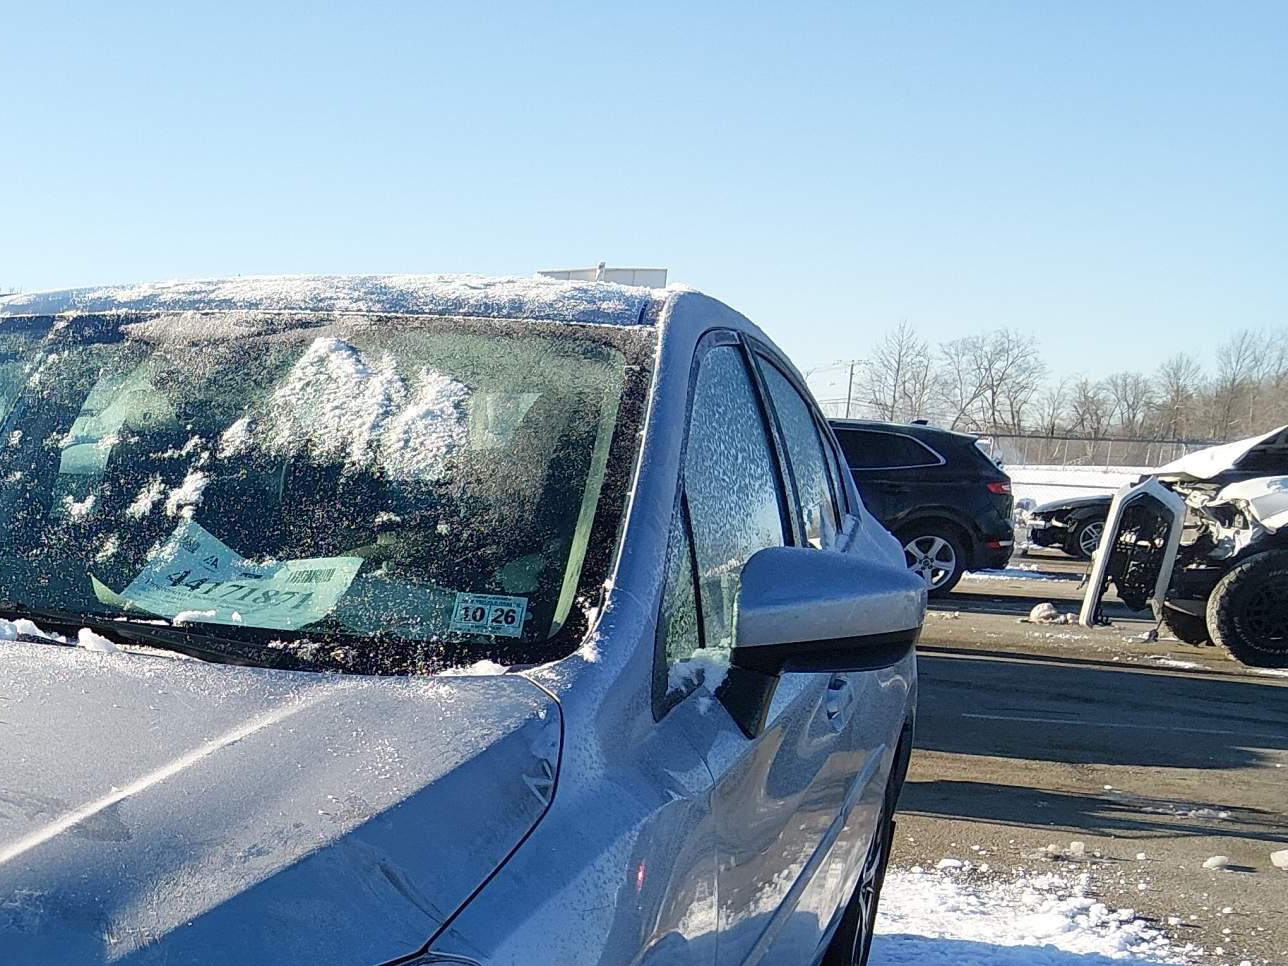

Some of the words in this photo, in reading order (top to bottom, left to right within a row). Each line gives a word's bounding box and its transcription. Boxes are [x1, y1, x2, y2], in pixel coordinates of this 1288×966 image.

[167, 569, 314, 610] 44171871
[461, 606, 486, 623] 10
[491, 607, 517, 626] 26
